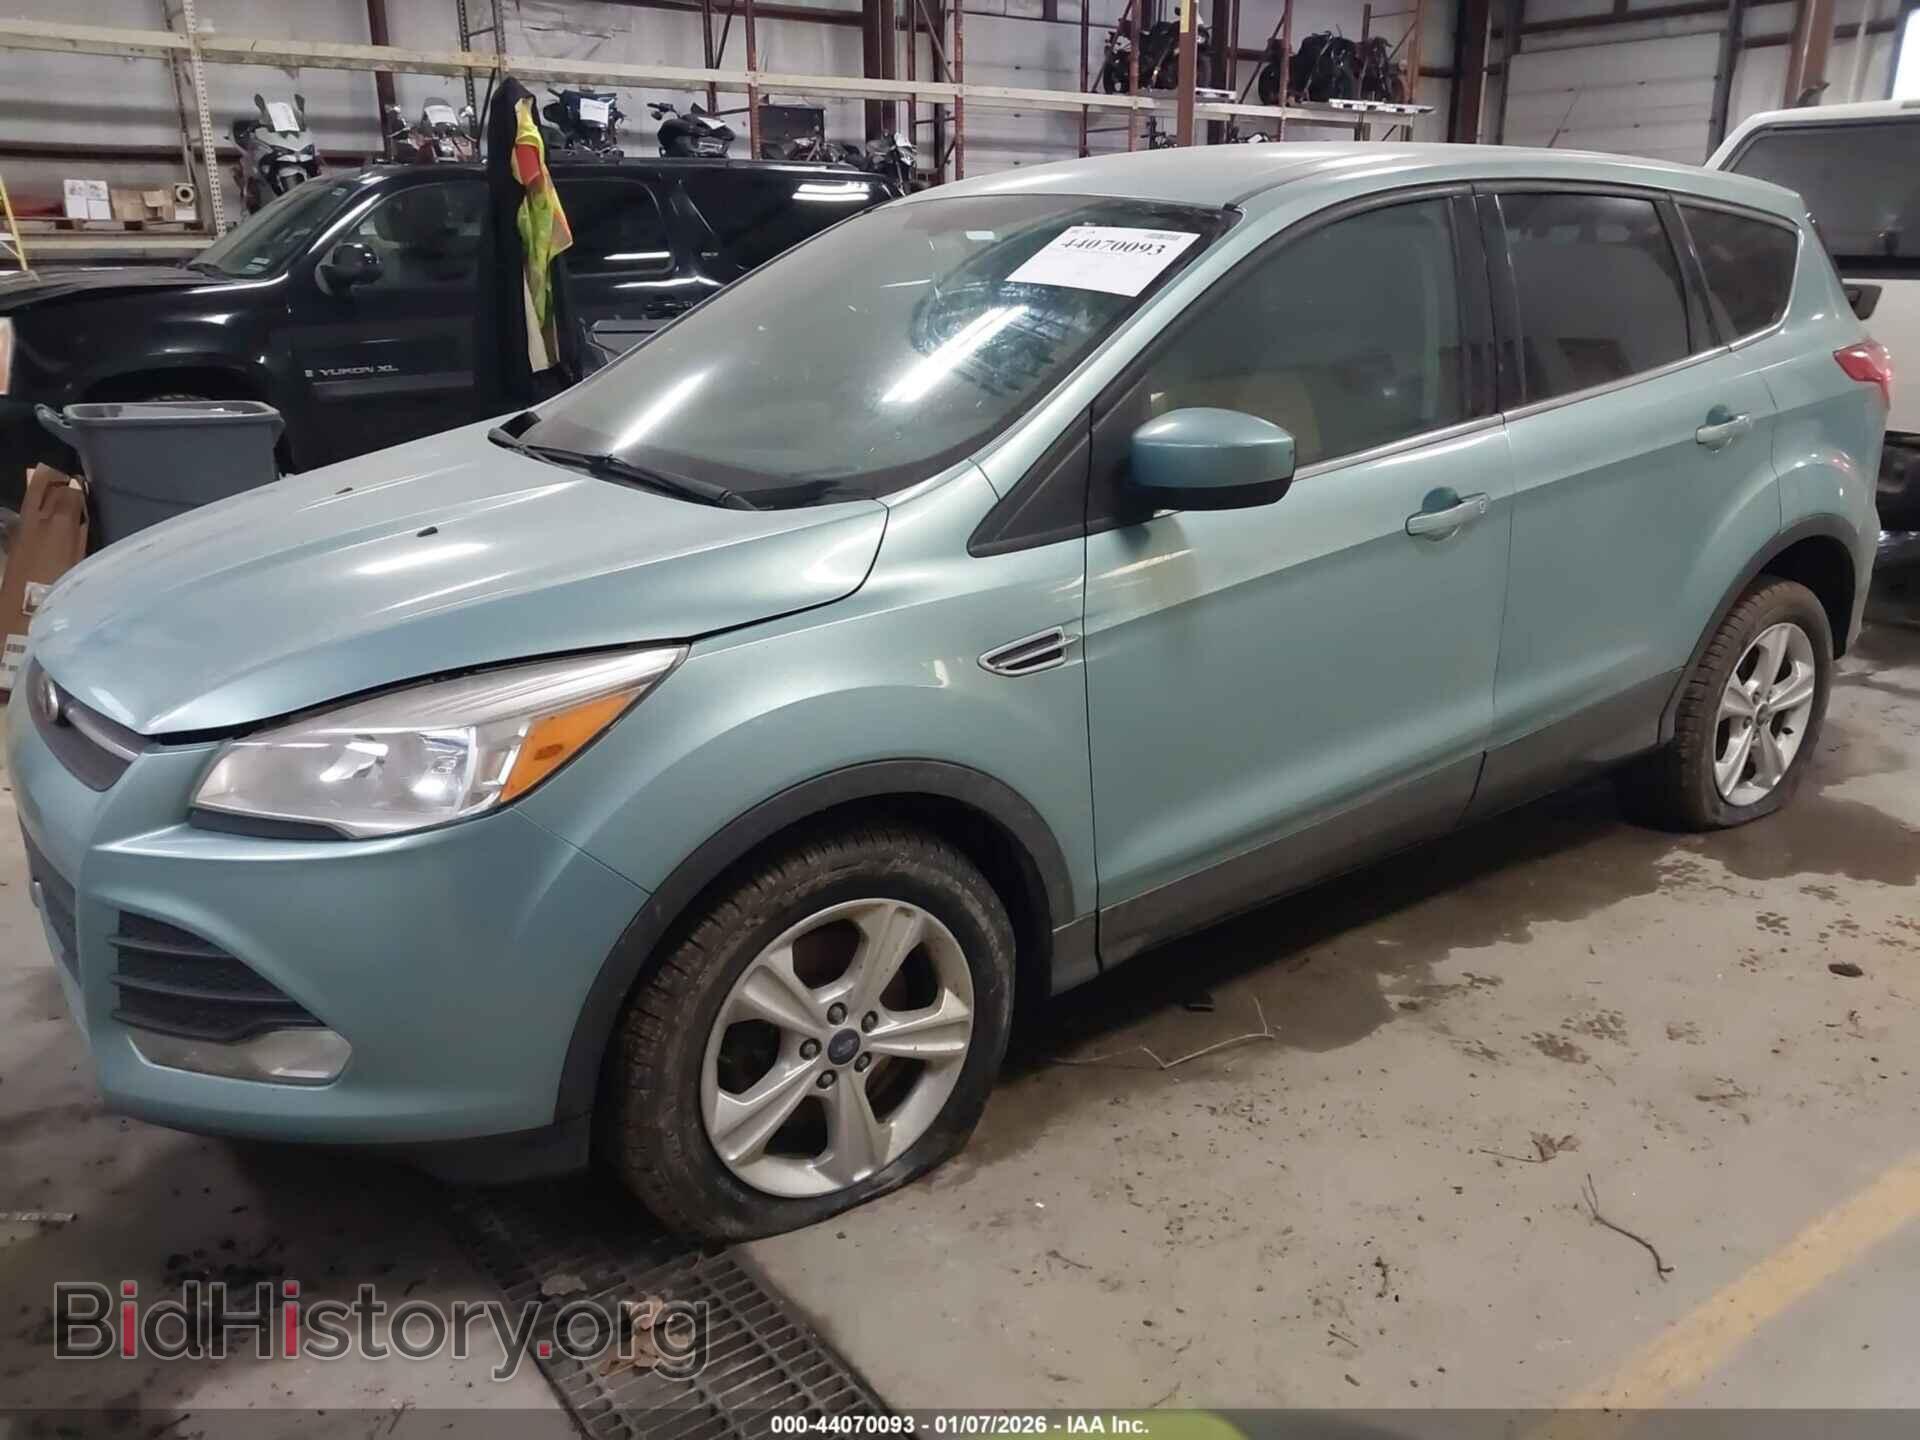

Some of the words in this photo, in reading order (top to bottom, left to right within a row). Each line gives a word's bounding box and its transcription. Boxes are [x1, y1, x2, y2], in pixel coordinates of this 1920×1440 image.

[1062, 238, 1166, 256] 44070093
[319, 366, 374, 376] YUKON
[377, 364, 400, 373] XL
